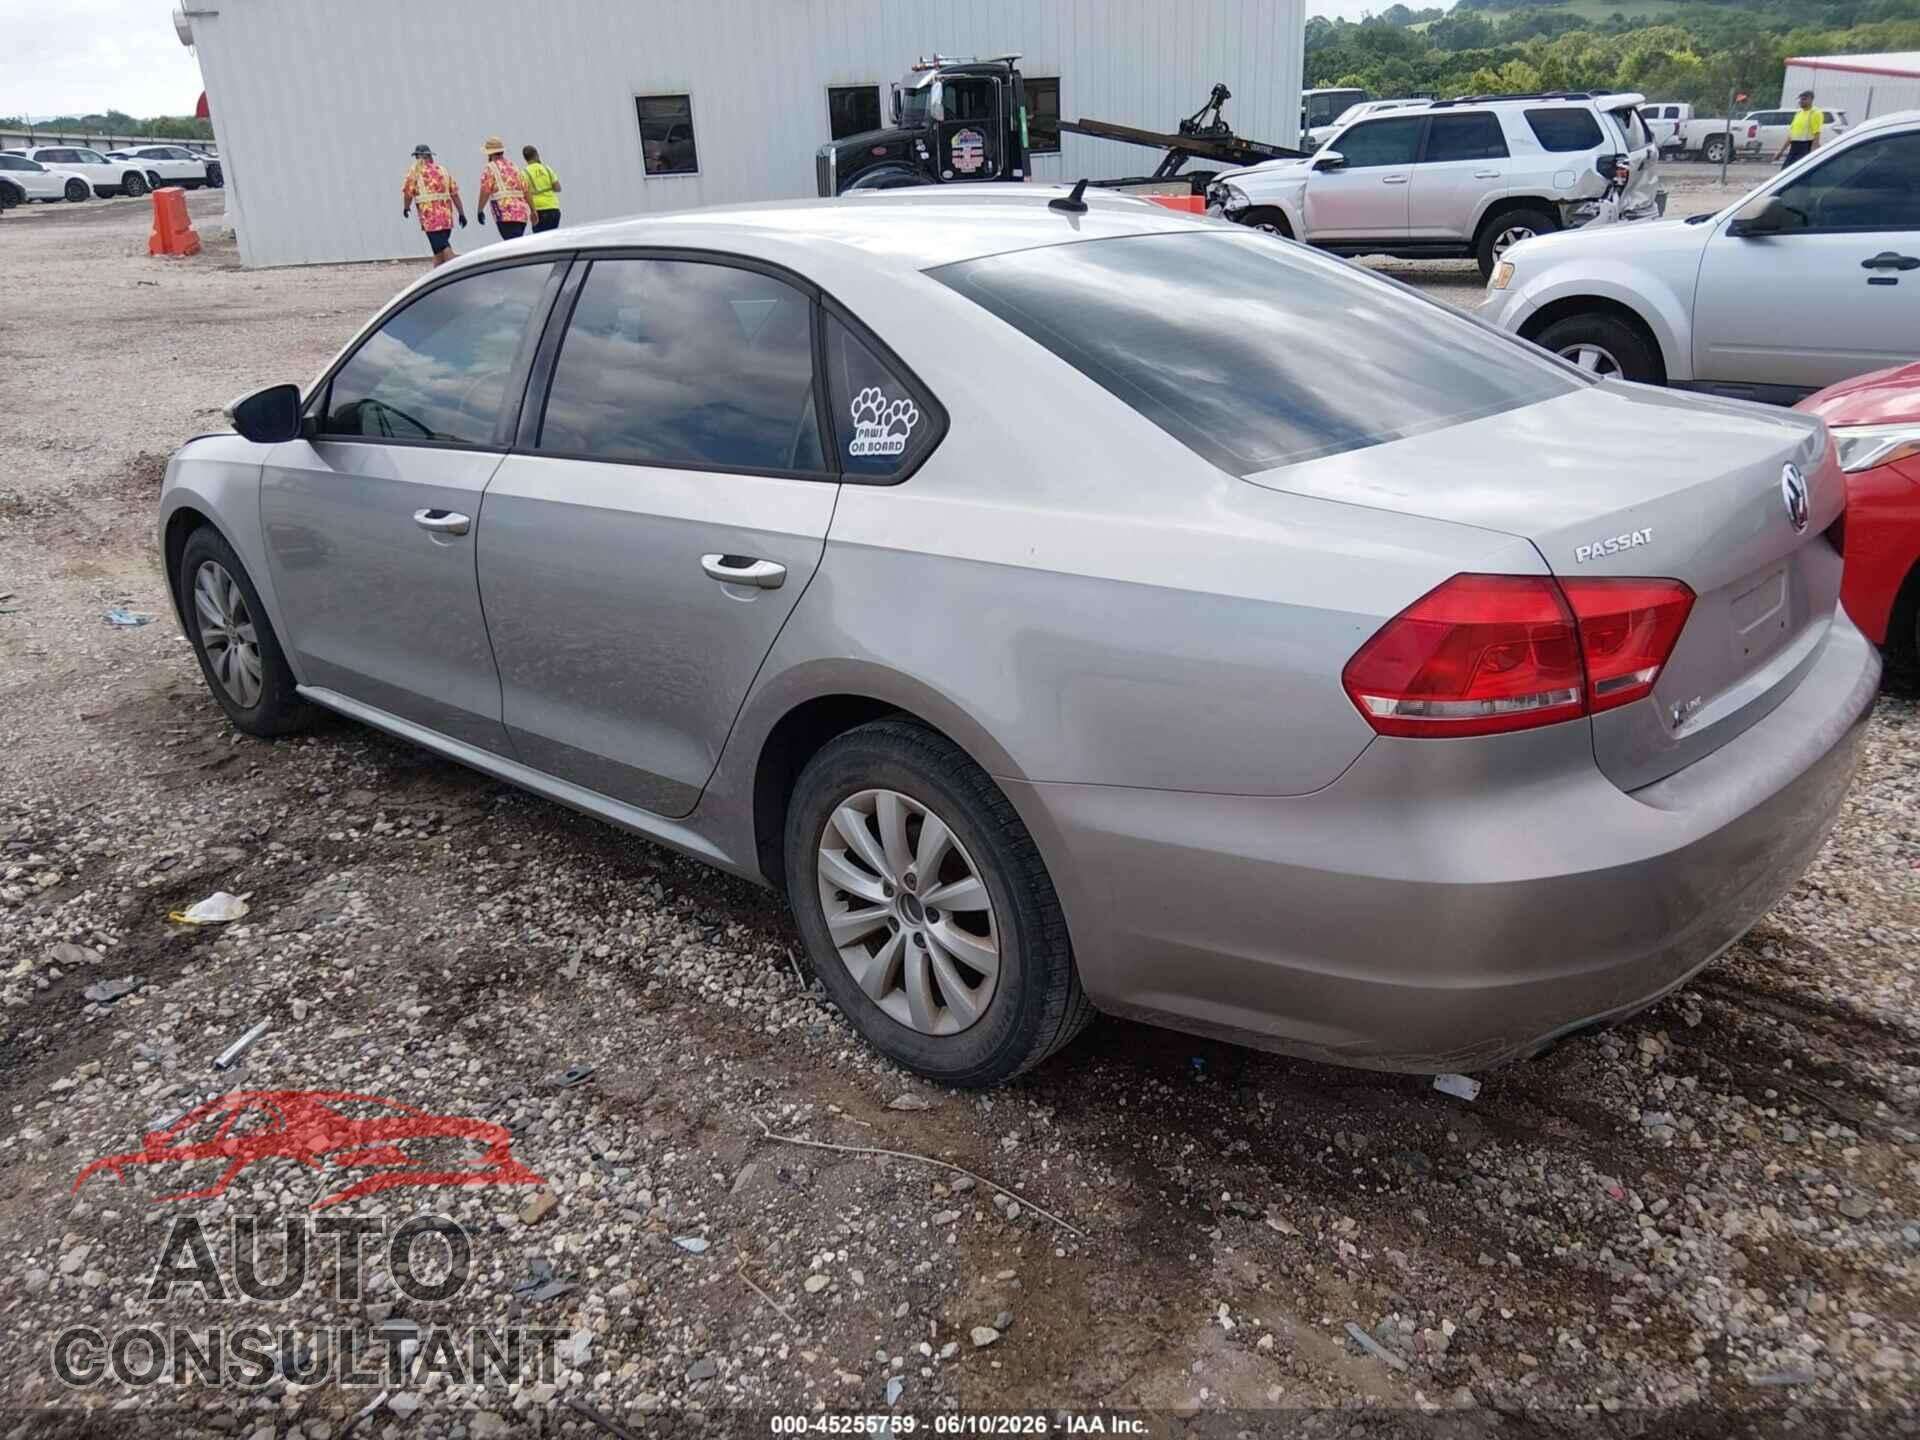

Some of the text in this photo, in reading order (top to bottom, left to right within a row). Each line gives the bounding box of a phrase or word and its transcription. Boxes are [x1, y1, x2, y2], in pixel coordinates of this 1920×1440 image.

[857, 428, 884, 438] PAWS
[851, 441, 903, 452] ON BOARD
[1575, 527, 1653, 563] PASSAT
